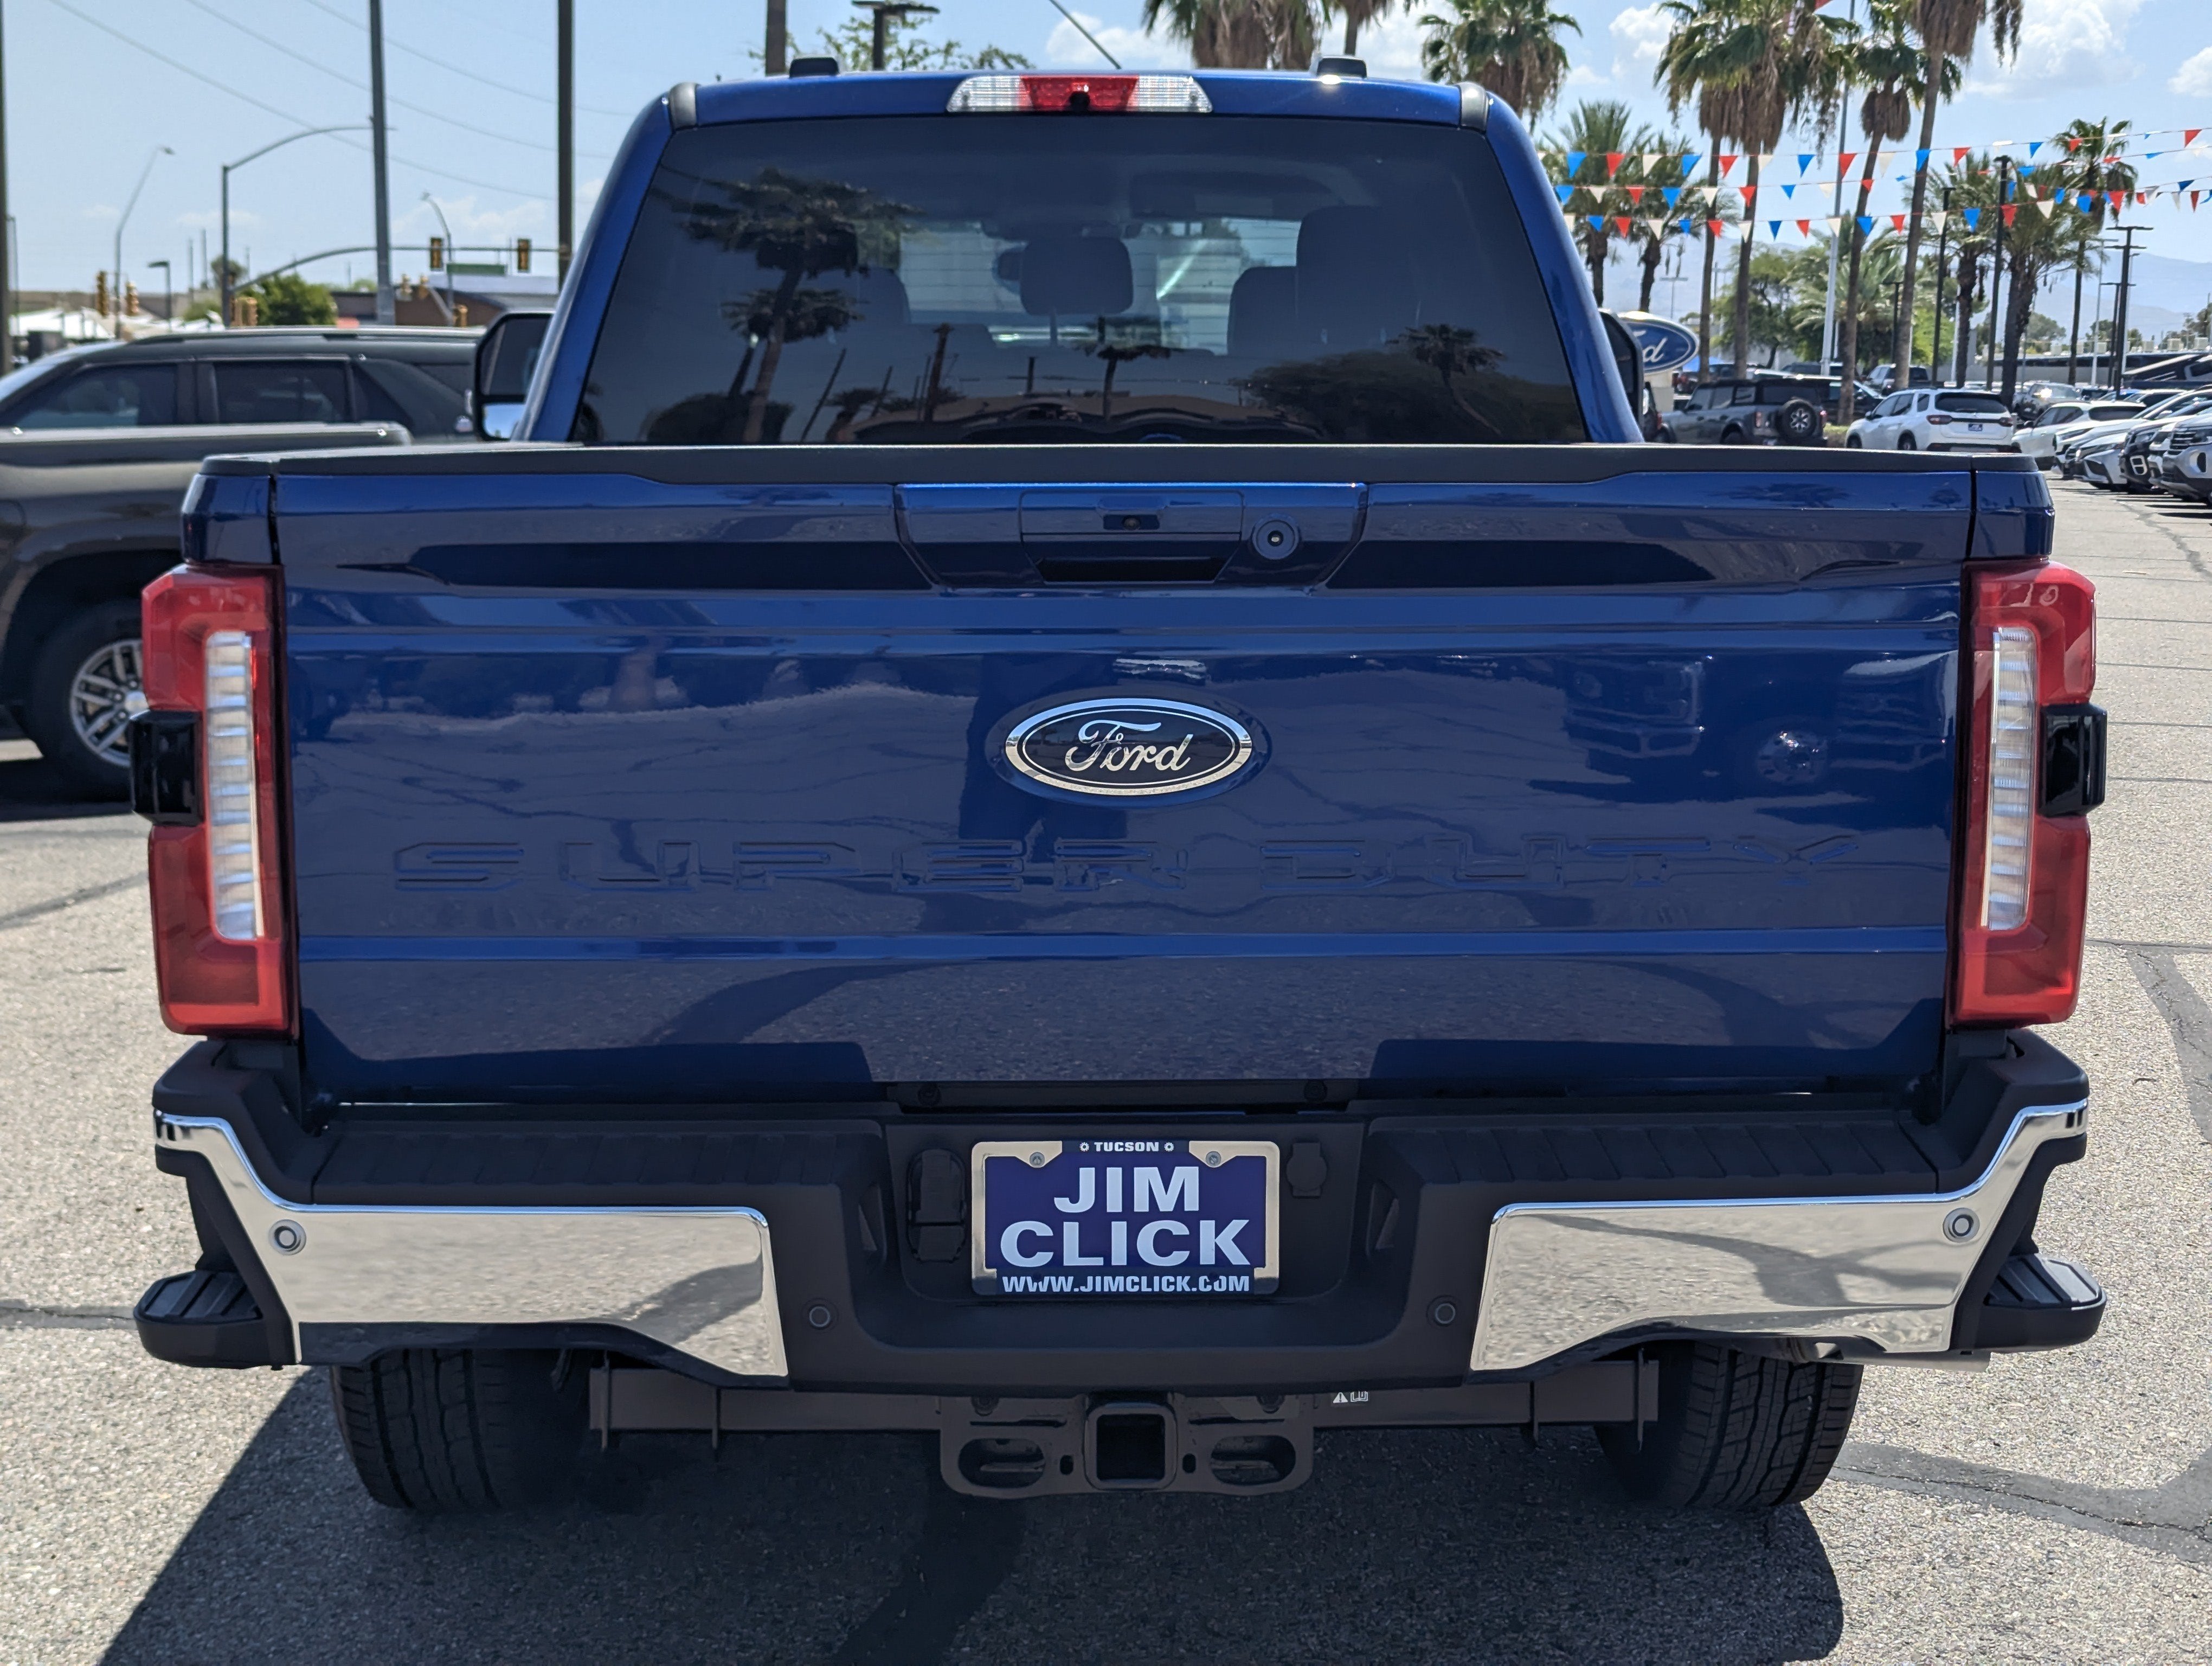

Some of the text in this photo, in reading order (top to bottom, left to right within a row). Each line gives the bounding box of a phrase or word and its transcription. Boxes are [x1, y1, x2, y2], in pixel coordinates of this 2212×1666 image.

[1064, 719, 1193, 771] Ford
[393, 834, 1860, 892] SUPER DUTY
[1094, 1142, 1159, 1152] TUCSON
[1053, 1166, 1199, 1213] JIM
[1000, 1219, 1251, 1267] CLICK
[1002, 1275, 1249, 1292] WWW.JIMCLICK.COM
